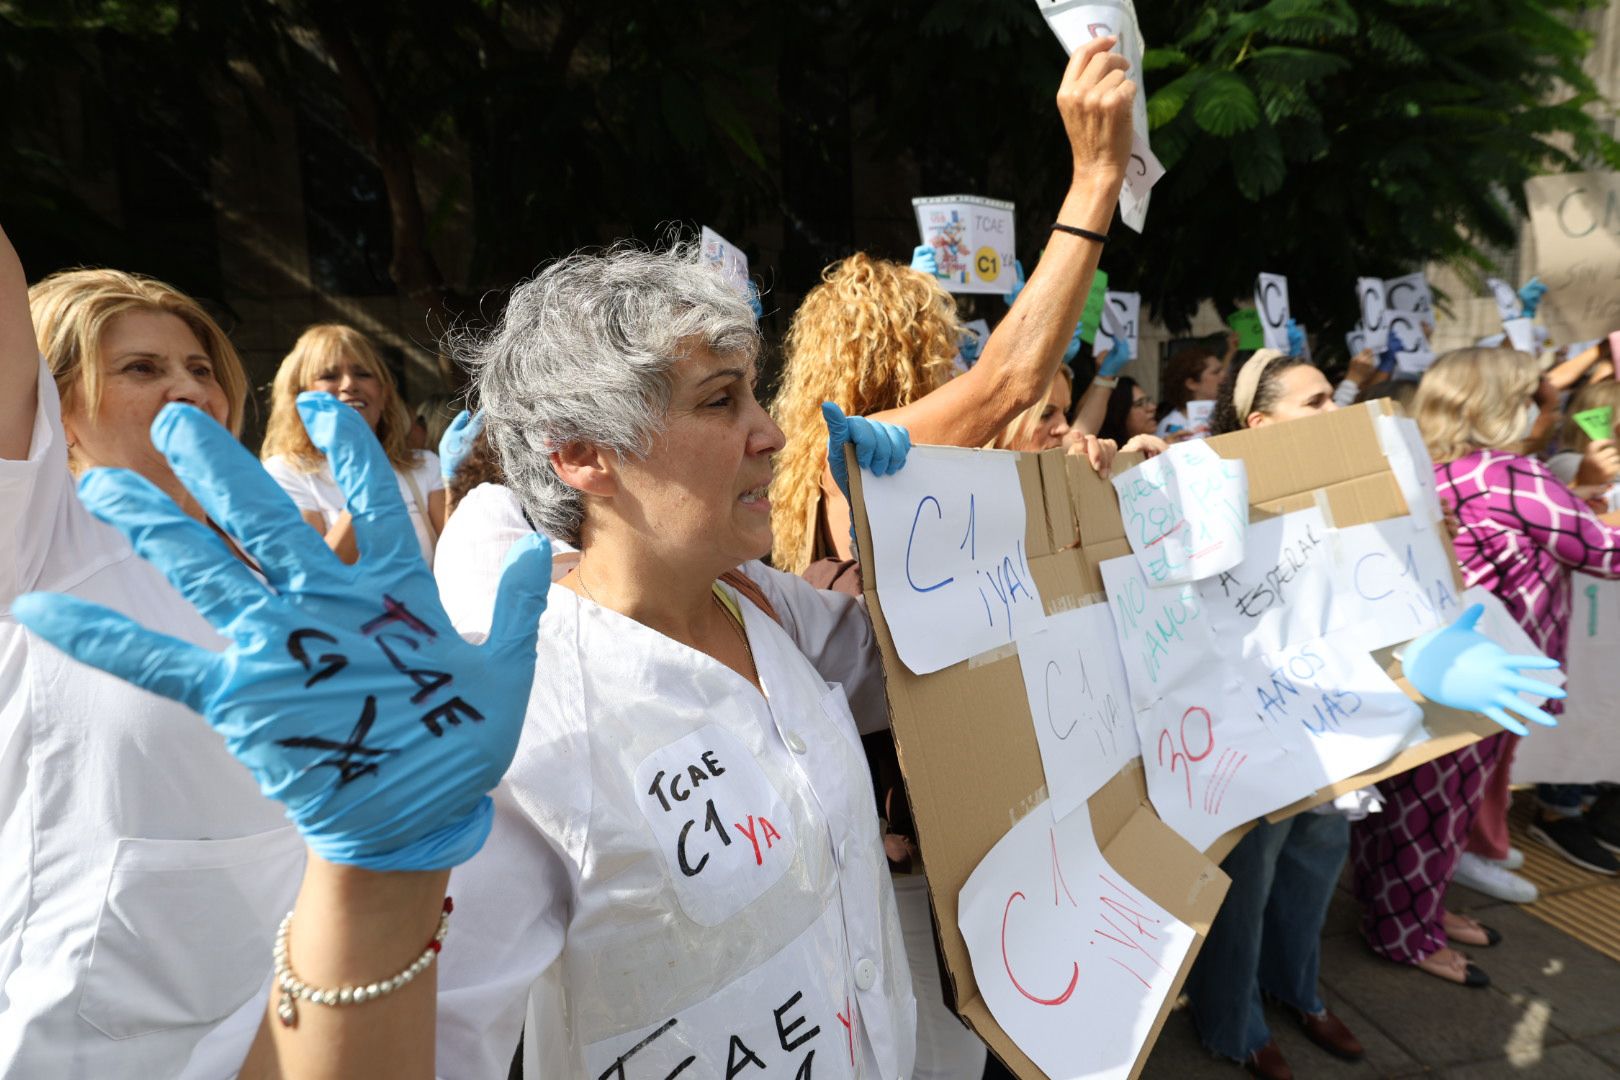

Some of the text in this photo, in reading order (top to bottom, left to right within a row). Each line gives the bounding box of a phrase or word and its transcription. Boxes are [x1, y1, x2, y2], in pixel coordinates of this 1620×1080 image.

[975, 214, 1004, 235] TCAE
[977, 255, 997, 274] C1
[906, 492, 976, 593] C1
[1354, 543, 1420, 601] C1
[1117, 576, 1146, 641] NO
[1218, 570, 1240, 598] A
[286, 628, 349, 688] C1
[360, 593, 486, 738] TCAE
[1045, 648, 1094, 740] C1
[648, 750, 726, 812] TCAE
[1157, 705, 1215, 810] 30
[677, 799, 782, 877] C1 YA
[1002, 827, 1079, 1006] C1
